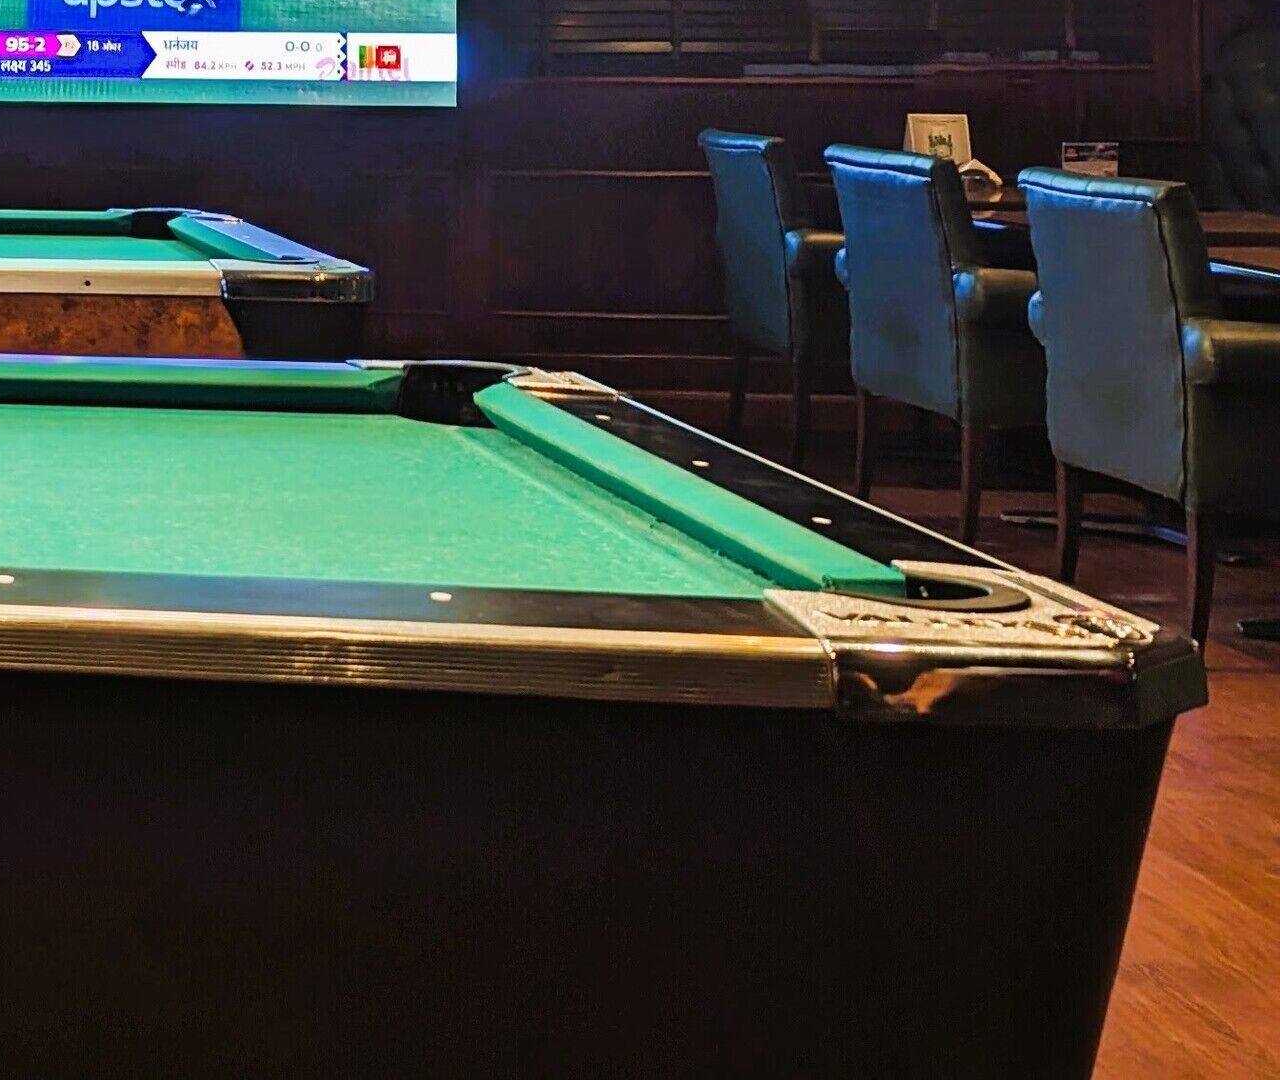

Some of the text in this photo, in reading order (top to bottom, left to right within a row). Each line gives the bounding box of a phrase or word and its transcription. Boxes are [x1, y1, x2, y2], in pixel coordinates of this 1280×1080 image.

[5, 37, 47, 52] 95-2
[87, 40, 100, 52] 18
[163, 36, 199, 51] धनंजय
[0, 60, 51, 74] लक्ष्य 345
[194, 61, 216, 70] 84.2
[219, 62, 237, 70] KPH
[261, 61, 282, 71] 52.3
[285, 63, 305, 71] MPH
